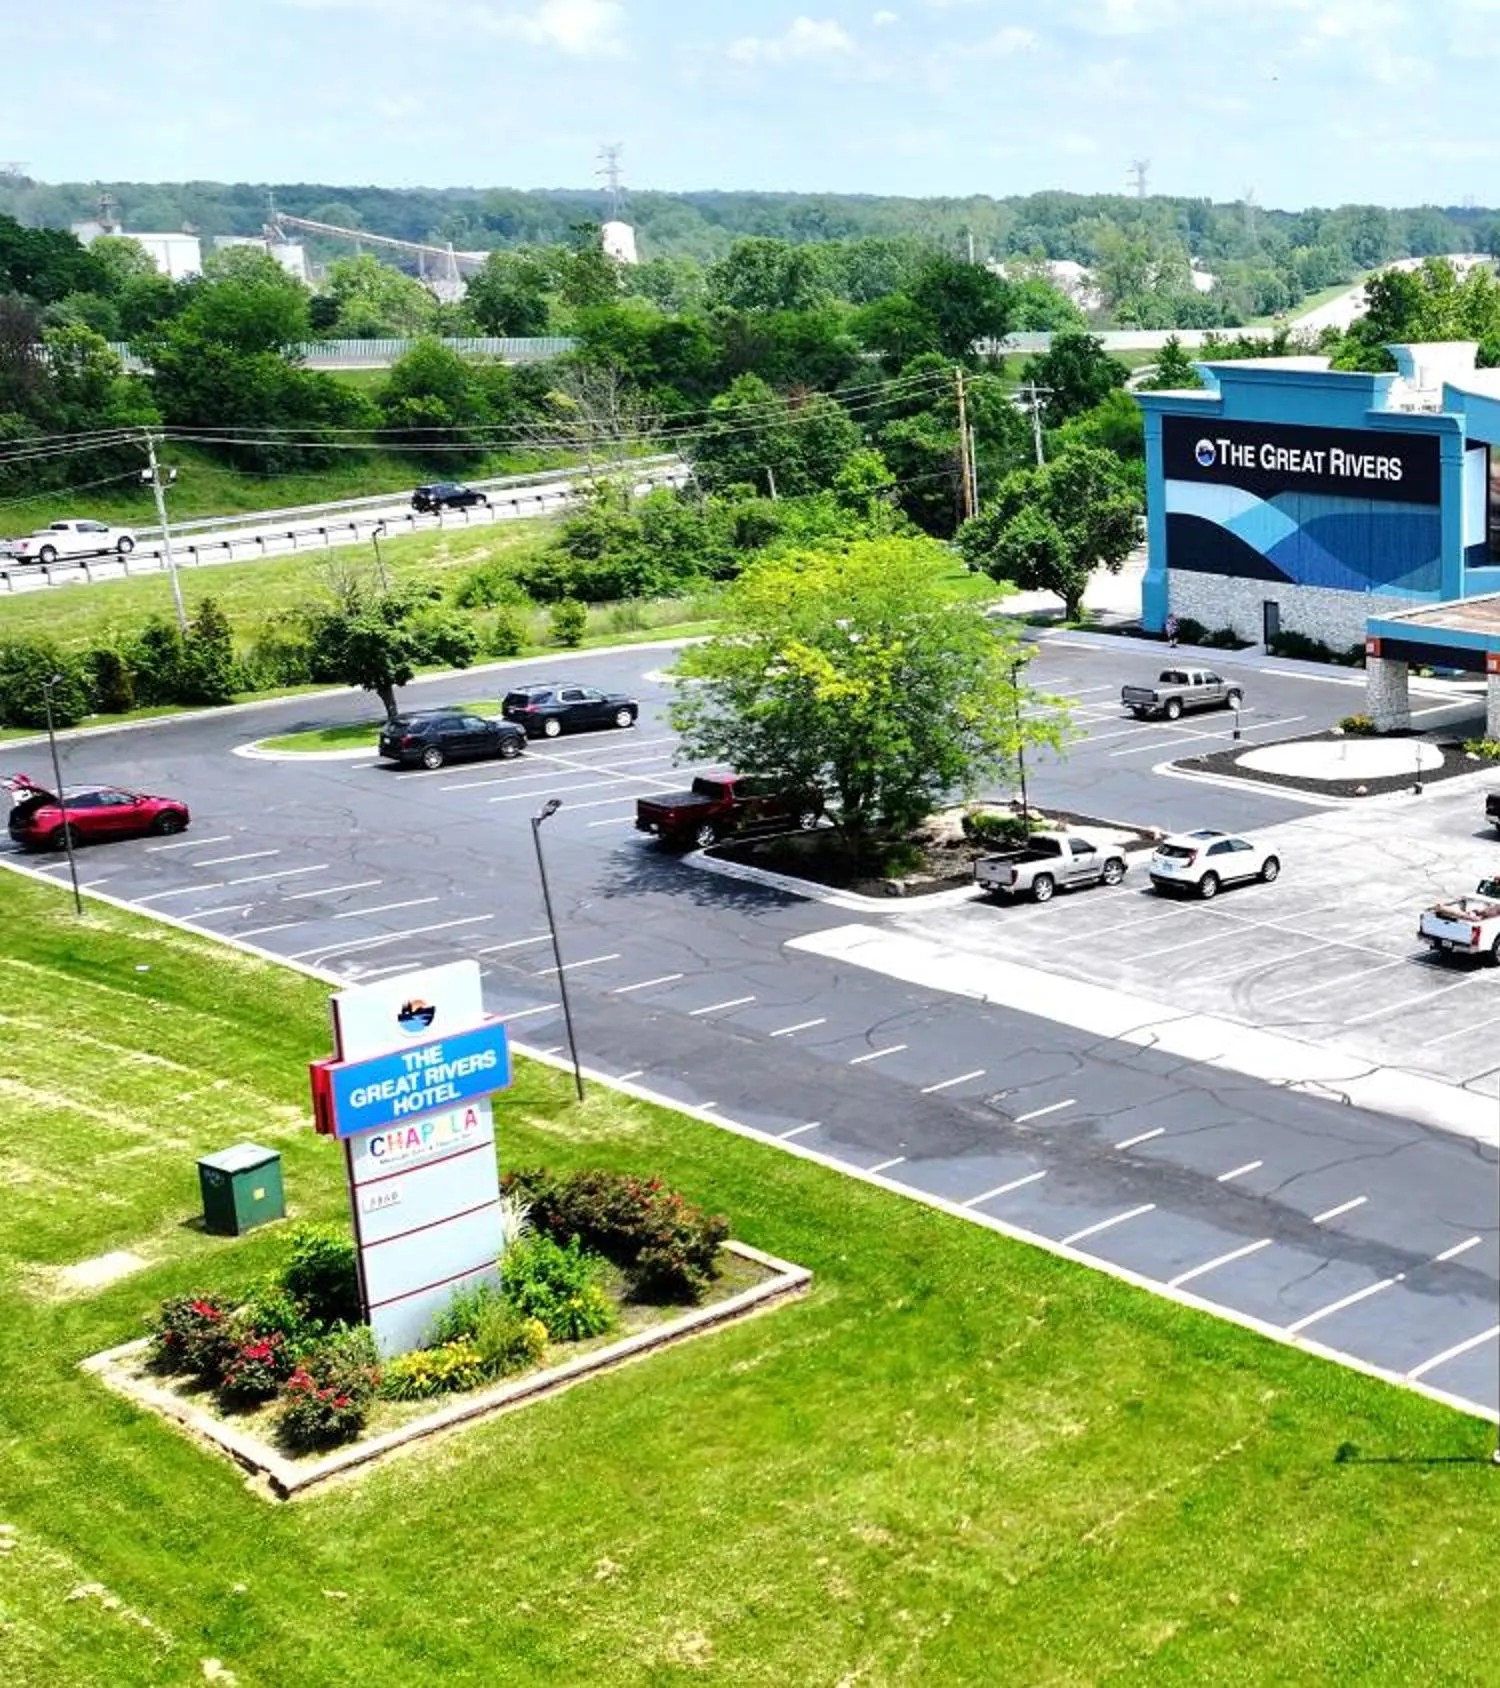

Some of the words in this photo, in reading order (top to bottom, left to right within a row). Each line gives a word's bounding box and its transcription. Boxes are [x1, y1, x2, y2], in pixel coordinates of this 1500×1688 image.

[1216, 439, 1255, 467] THE
[1259, 443, 1326, 475] GREAT
[1329, 448, 1403, 481] RIVERS
[402, 1045, 443, 1072] THE
[350, 1071, 419, 1109] GREAT
[425, 1050, 497, 1086] RIVERS
[393, 1083, 461, 1116] HOTEL
